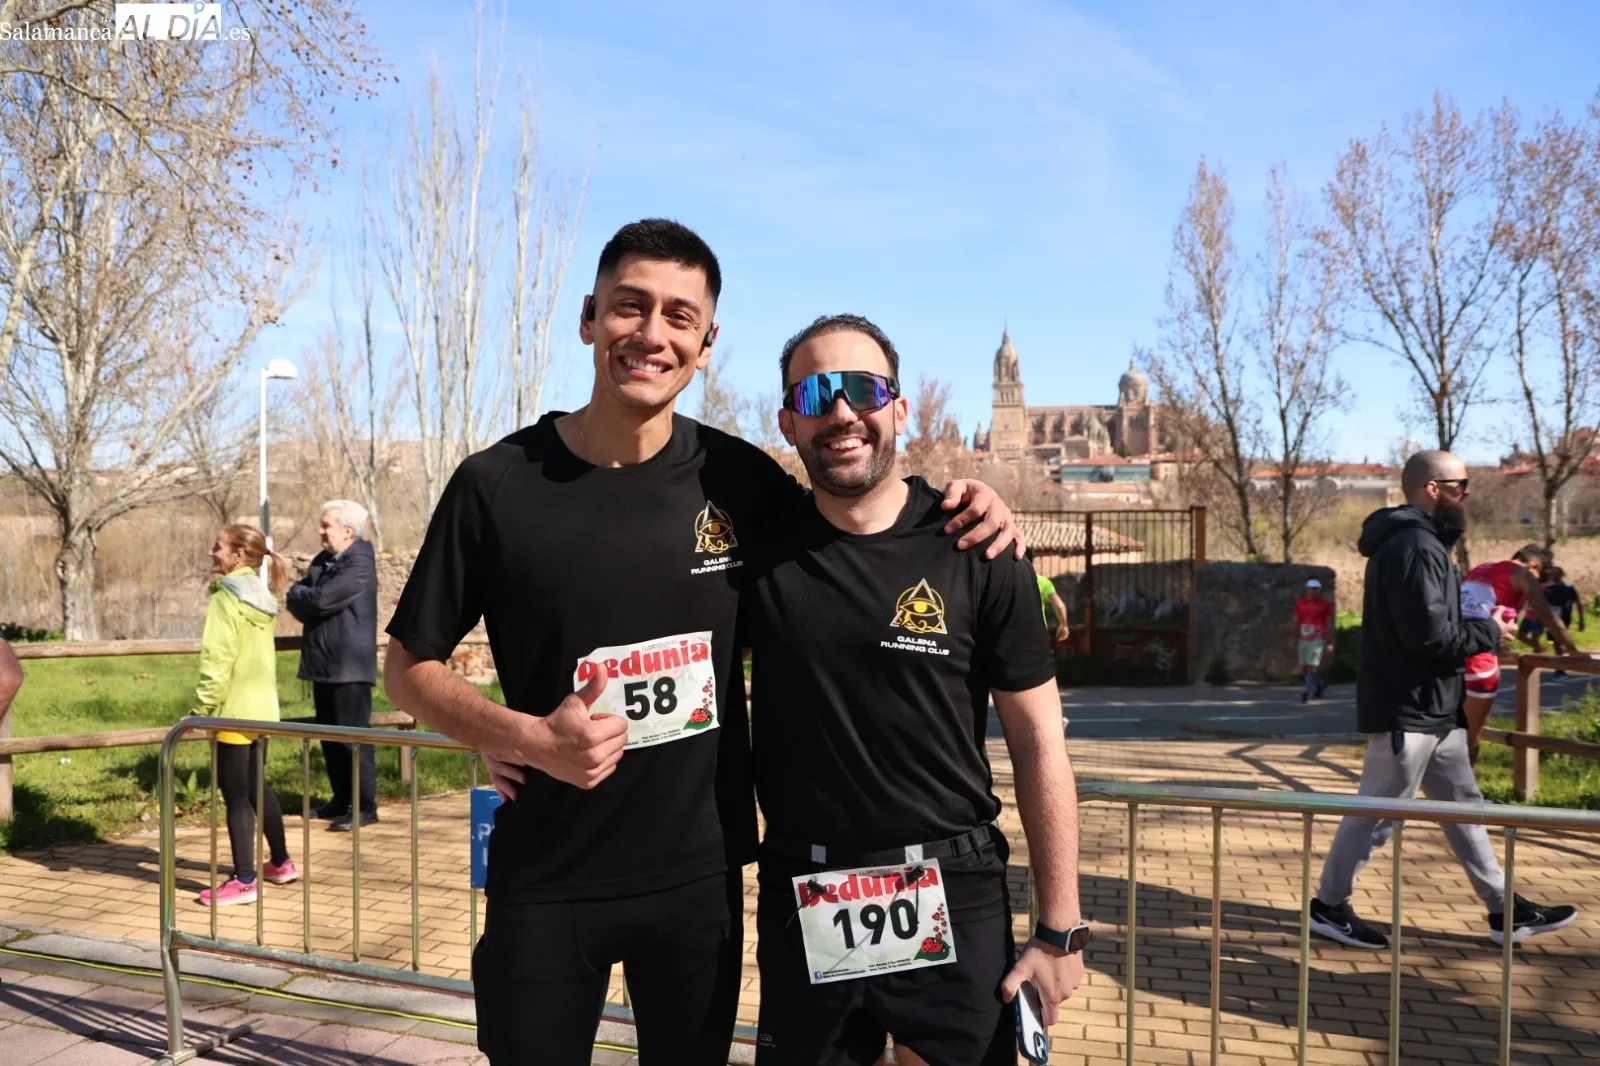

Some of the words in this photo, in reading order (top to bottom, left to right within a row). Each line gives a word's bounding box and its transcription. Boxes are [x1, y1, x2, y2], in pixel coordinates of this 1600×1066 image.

[691, 563, 726, 575] RUNNING
[726, 560, 743, 569] CLUB
[880, 641, 926, 653] RUNNING
[927, 647, 950, 656] CLUB
[897, 635, 937, 647] GALENA
[624, 676, 678, 721] 58
[833, 898, 919, 949] 190
